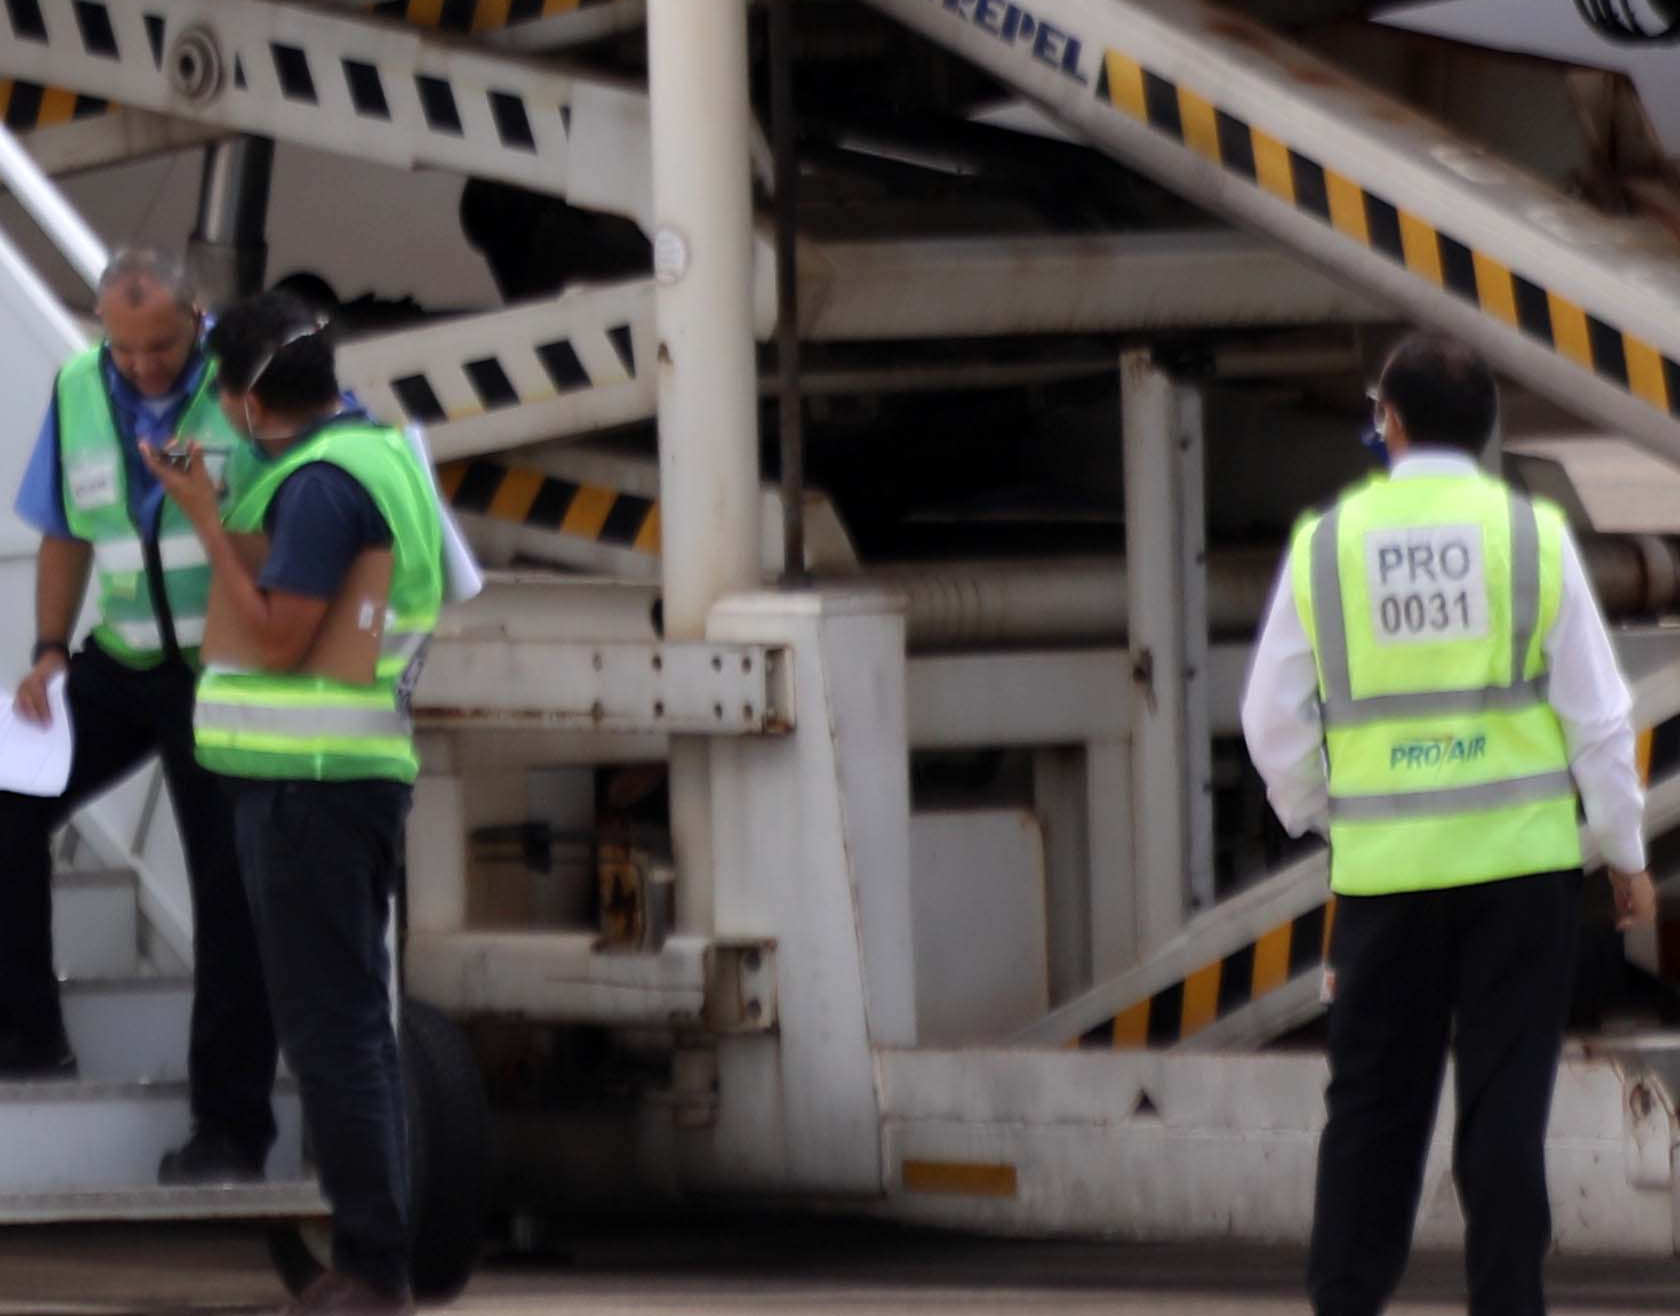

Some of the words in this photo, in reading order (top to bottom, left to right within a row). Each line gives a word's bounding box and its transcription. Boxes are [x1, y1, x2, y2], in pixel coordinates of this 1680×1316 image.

[1376, 540, 1471, 586] PRO
[1379, 590, 1471, 636] 0031
[1389, 743, 1443, 771] PRO
[1447, 734, 1488, 763] AIR
